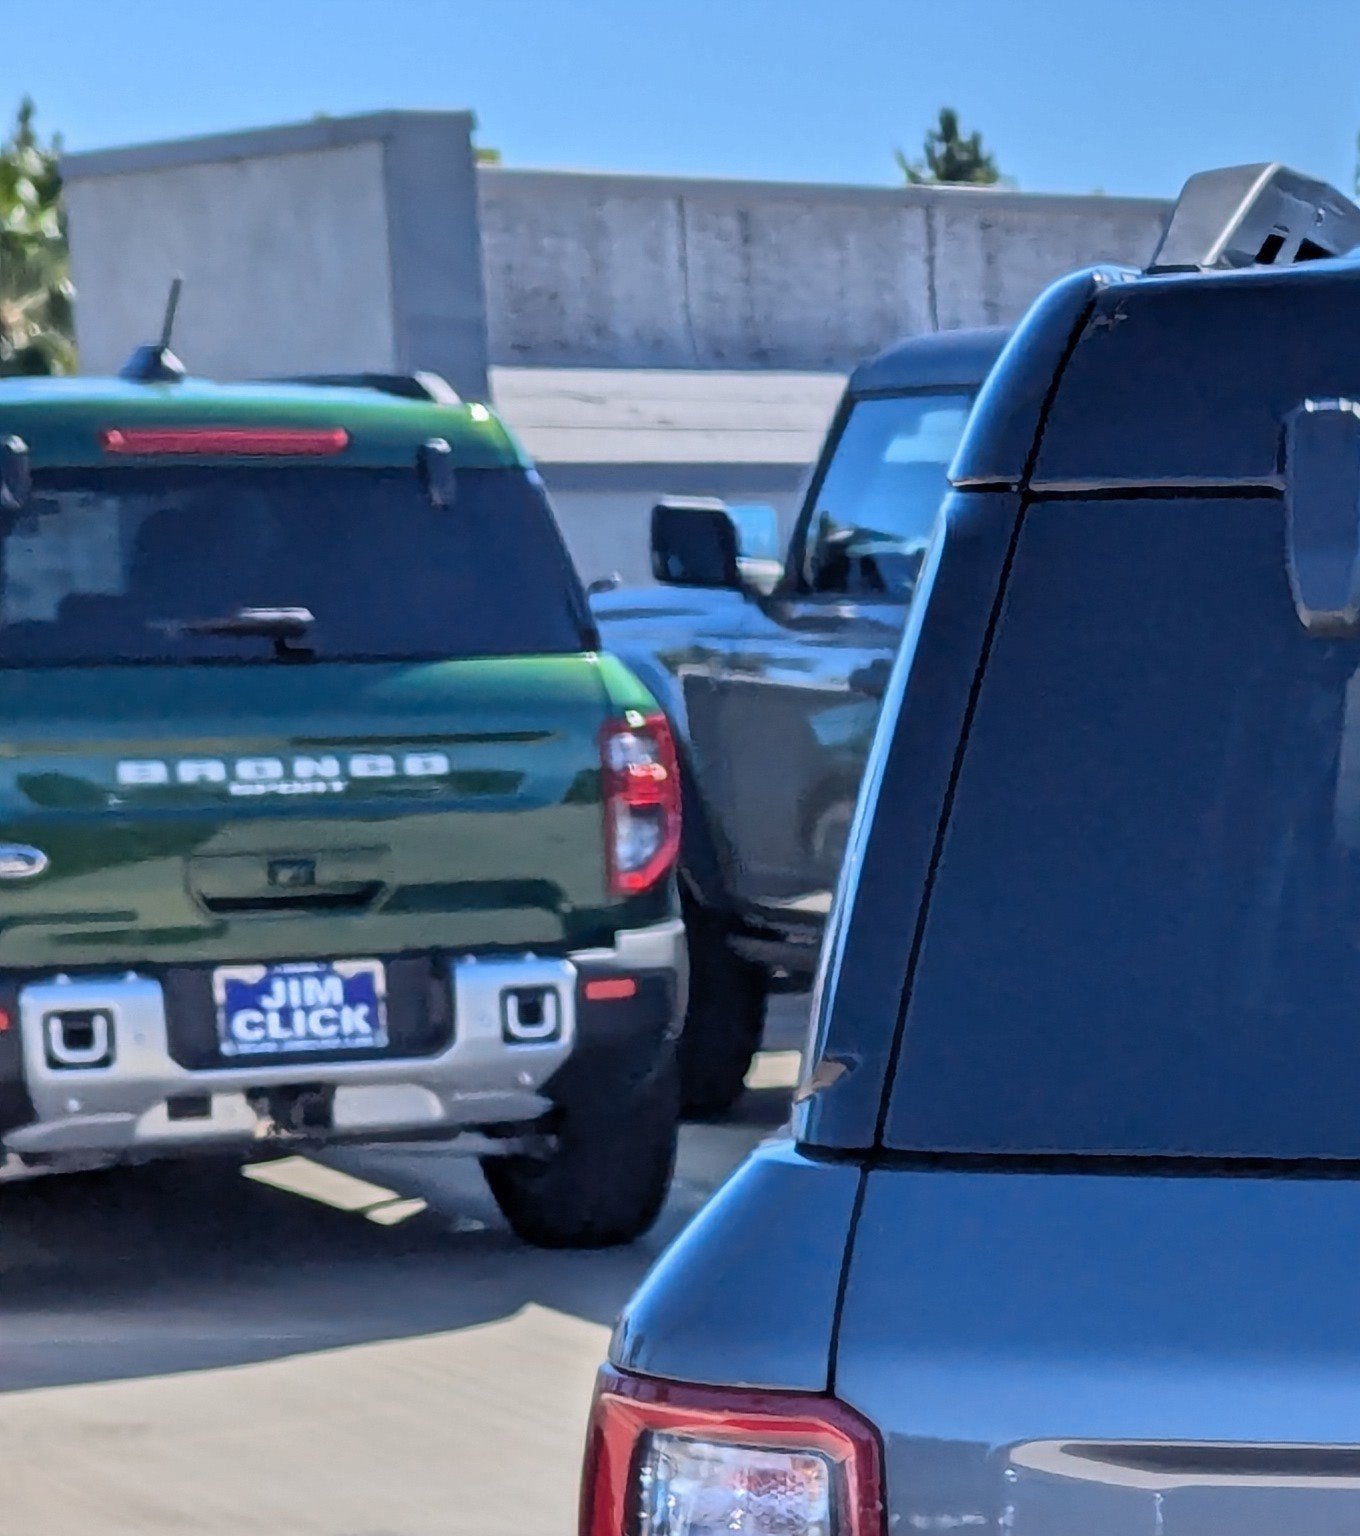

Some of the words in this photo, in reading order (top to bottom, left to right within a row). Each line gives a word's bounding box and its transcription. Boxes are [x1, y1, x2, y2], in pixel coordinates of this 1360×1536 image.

[116, 753, 449, 784] BRONCO
[260, 975, 344, 1010] JIM
[231, 1003, 373, 1042] CLICK
